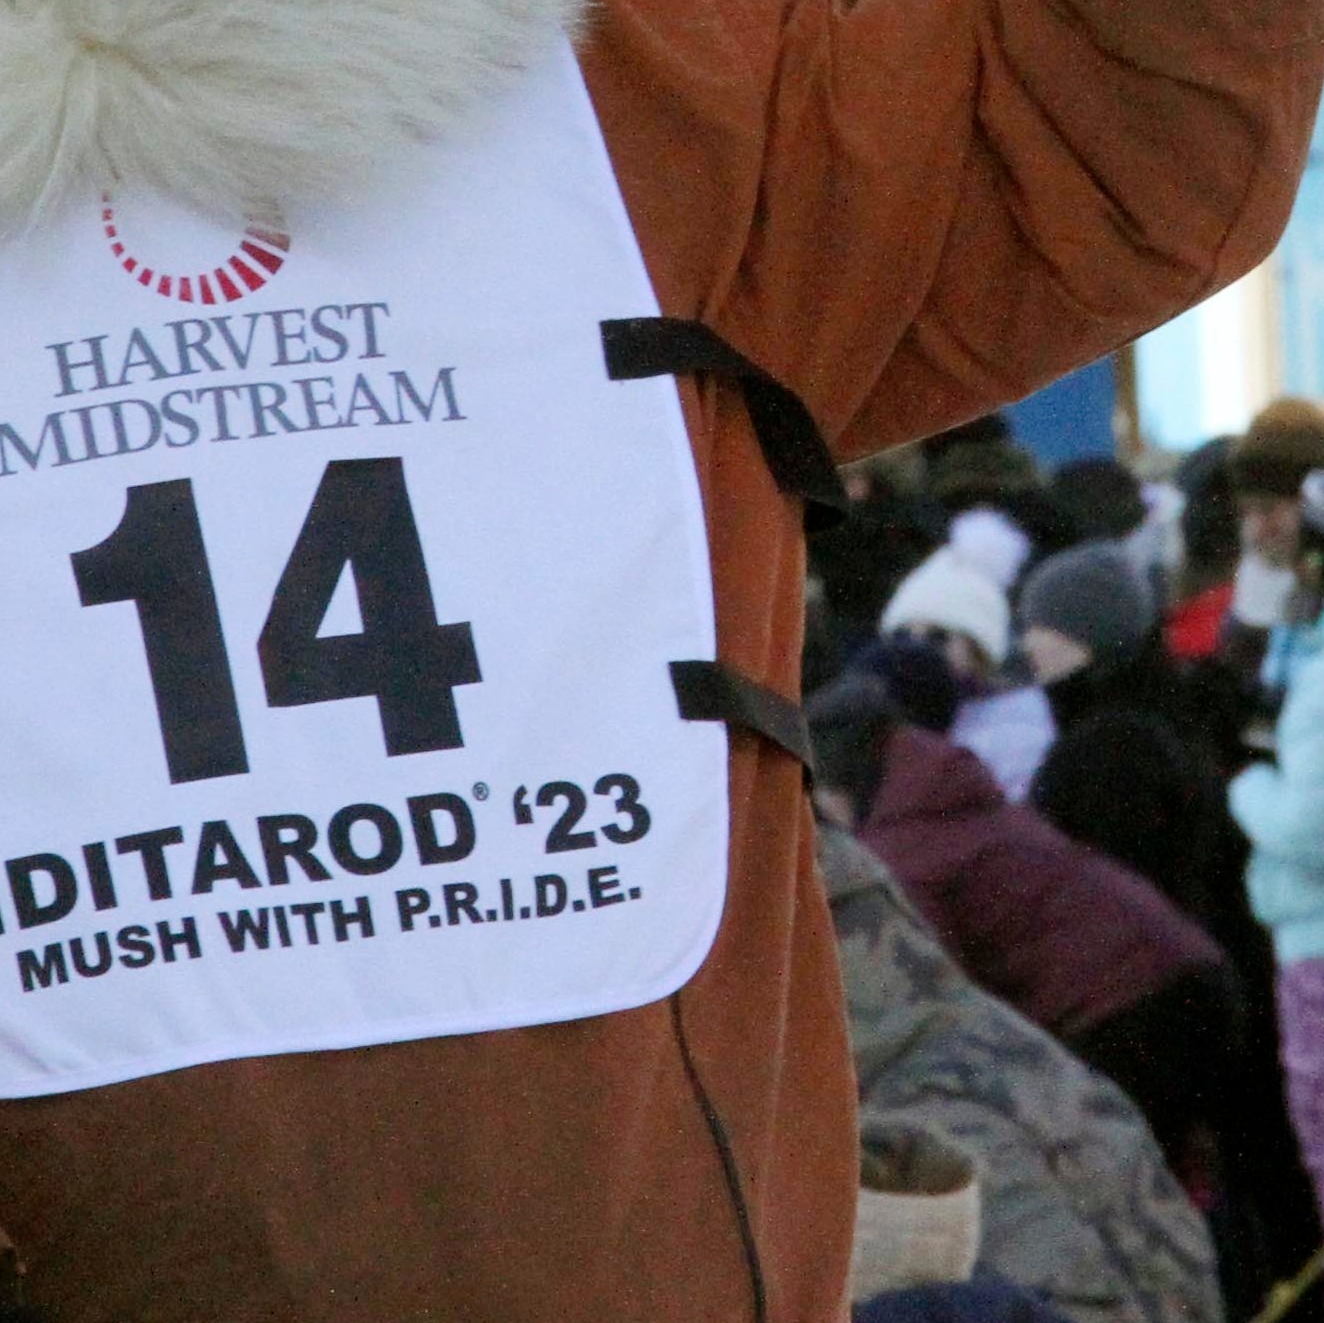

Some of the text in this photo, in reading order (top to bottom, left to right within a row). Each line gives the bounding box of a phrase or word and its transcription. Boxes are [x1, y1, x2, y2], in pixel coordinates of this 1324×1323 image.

[46, 302, 391, 398] HARVEST
[70, 457, 483, 784] 14
[16, 865, 642, 993] MUSH WITH P.R.I.D.E.
